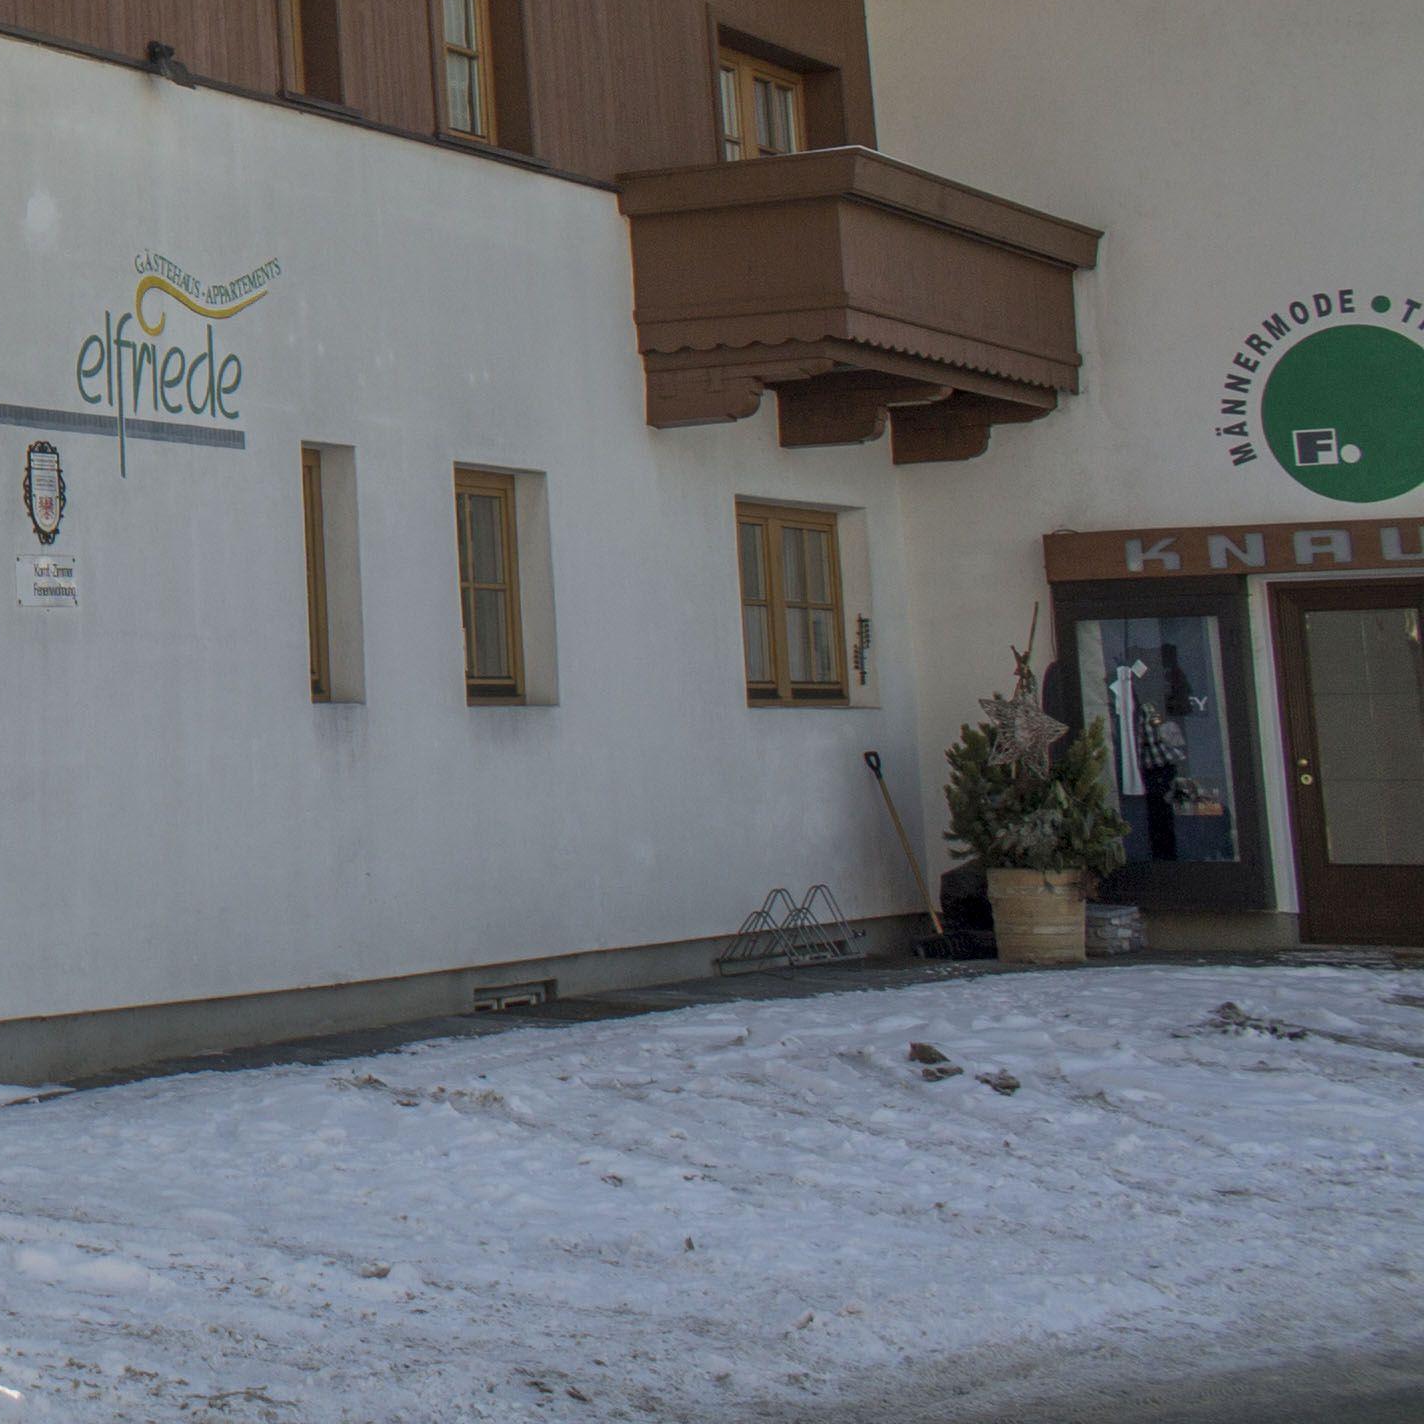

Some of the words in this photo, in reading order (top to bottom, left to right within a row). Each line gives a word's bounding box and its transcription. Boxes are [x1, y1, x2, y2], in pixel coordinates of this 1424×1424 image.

[134, 248, 201, 299] GÄSTEHAUS
[205, 257, 282, 305] APPARTEMENTS
[76, 310, 243, 478] elfriede
[1215, 289, 1356, 466] MÄNNERMODE
[1401, 298, 1424, 330] T
